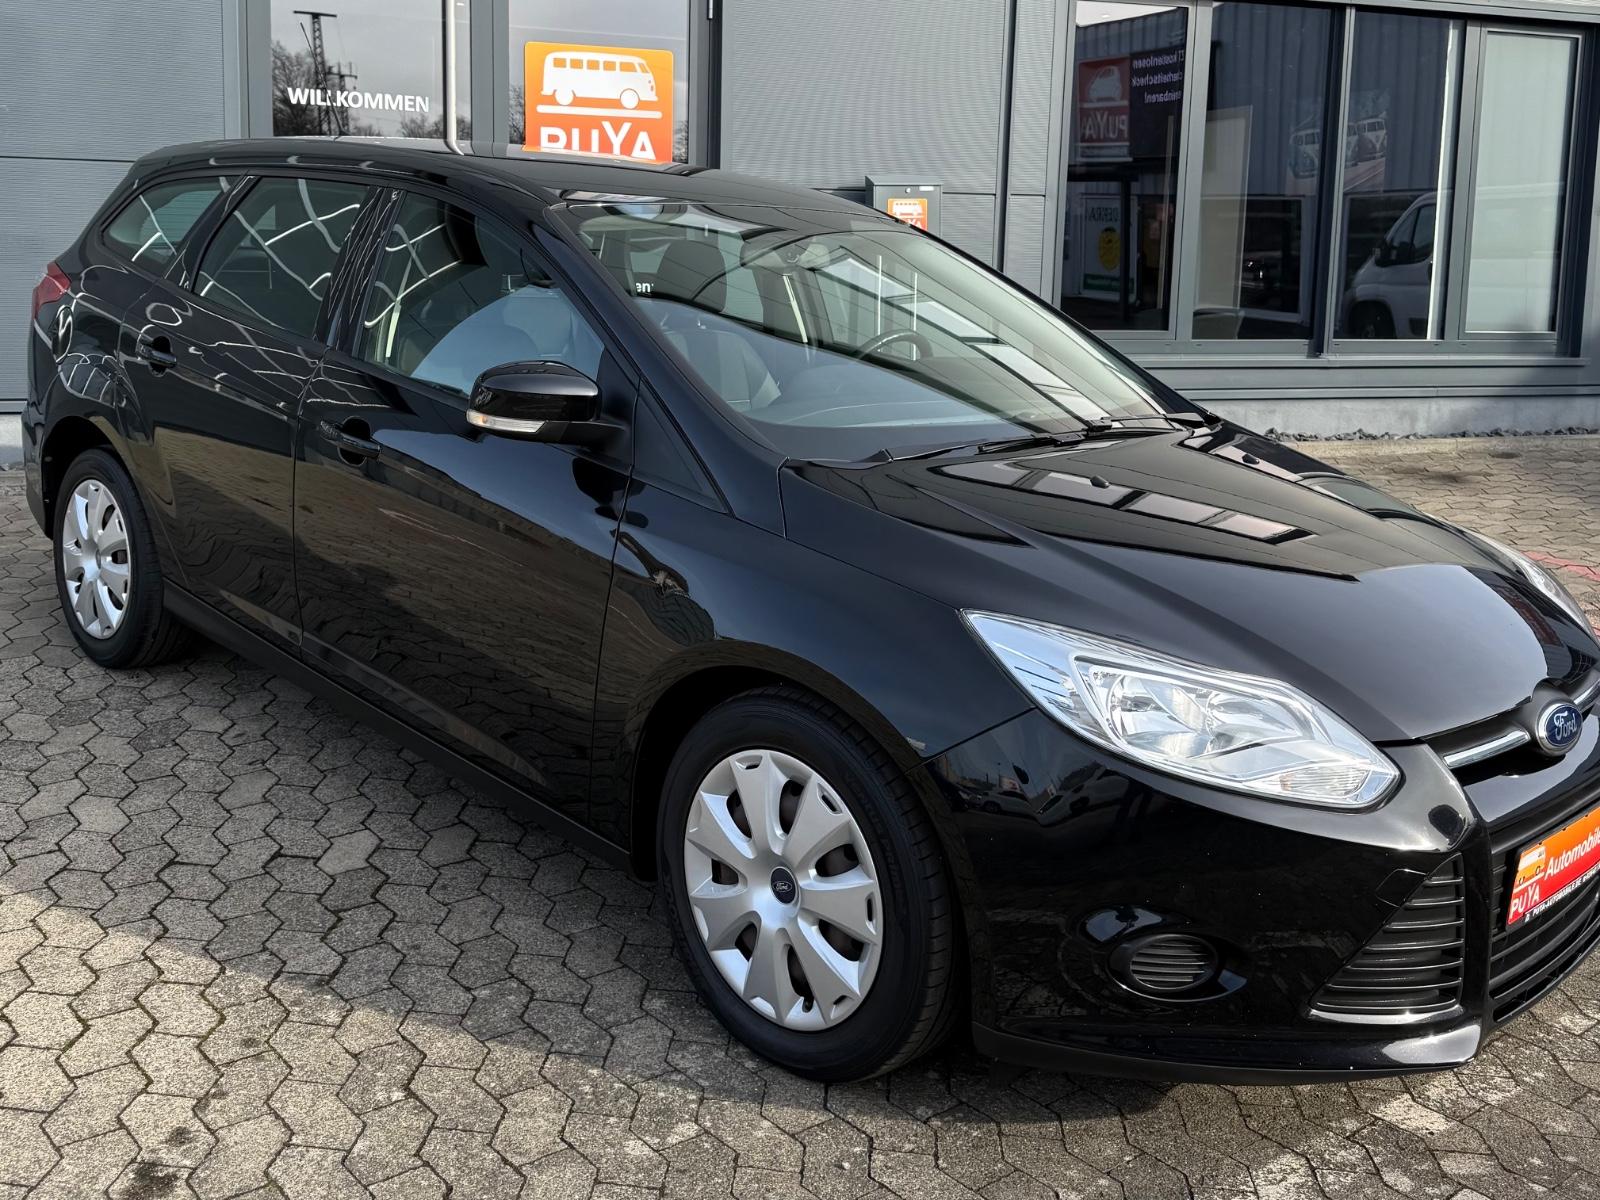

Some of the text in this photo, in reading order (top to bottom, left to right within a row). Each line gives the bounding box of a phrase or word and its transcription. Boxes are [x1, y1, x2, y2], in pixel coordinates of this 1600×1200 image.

[287, 87, 430, 112] WILLKOMMEN
[540, 121, 657, 160] PUYA
[1553, 710, 1579, 741] Ford
[1509, 882, 1540, 919] PUYA
